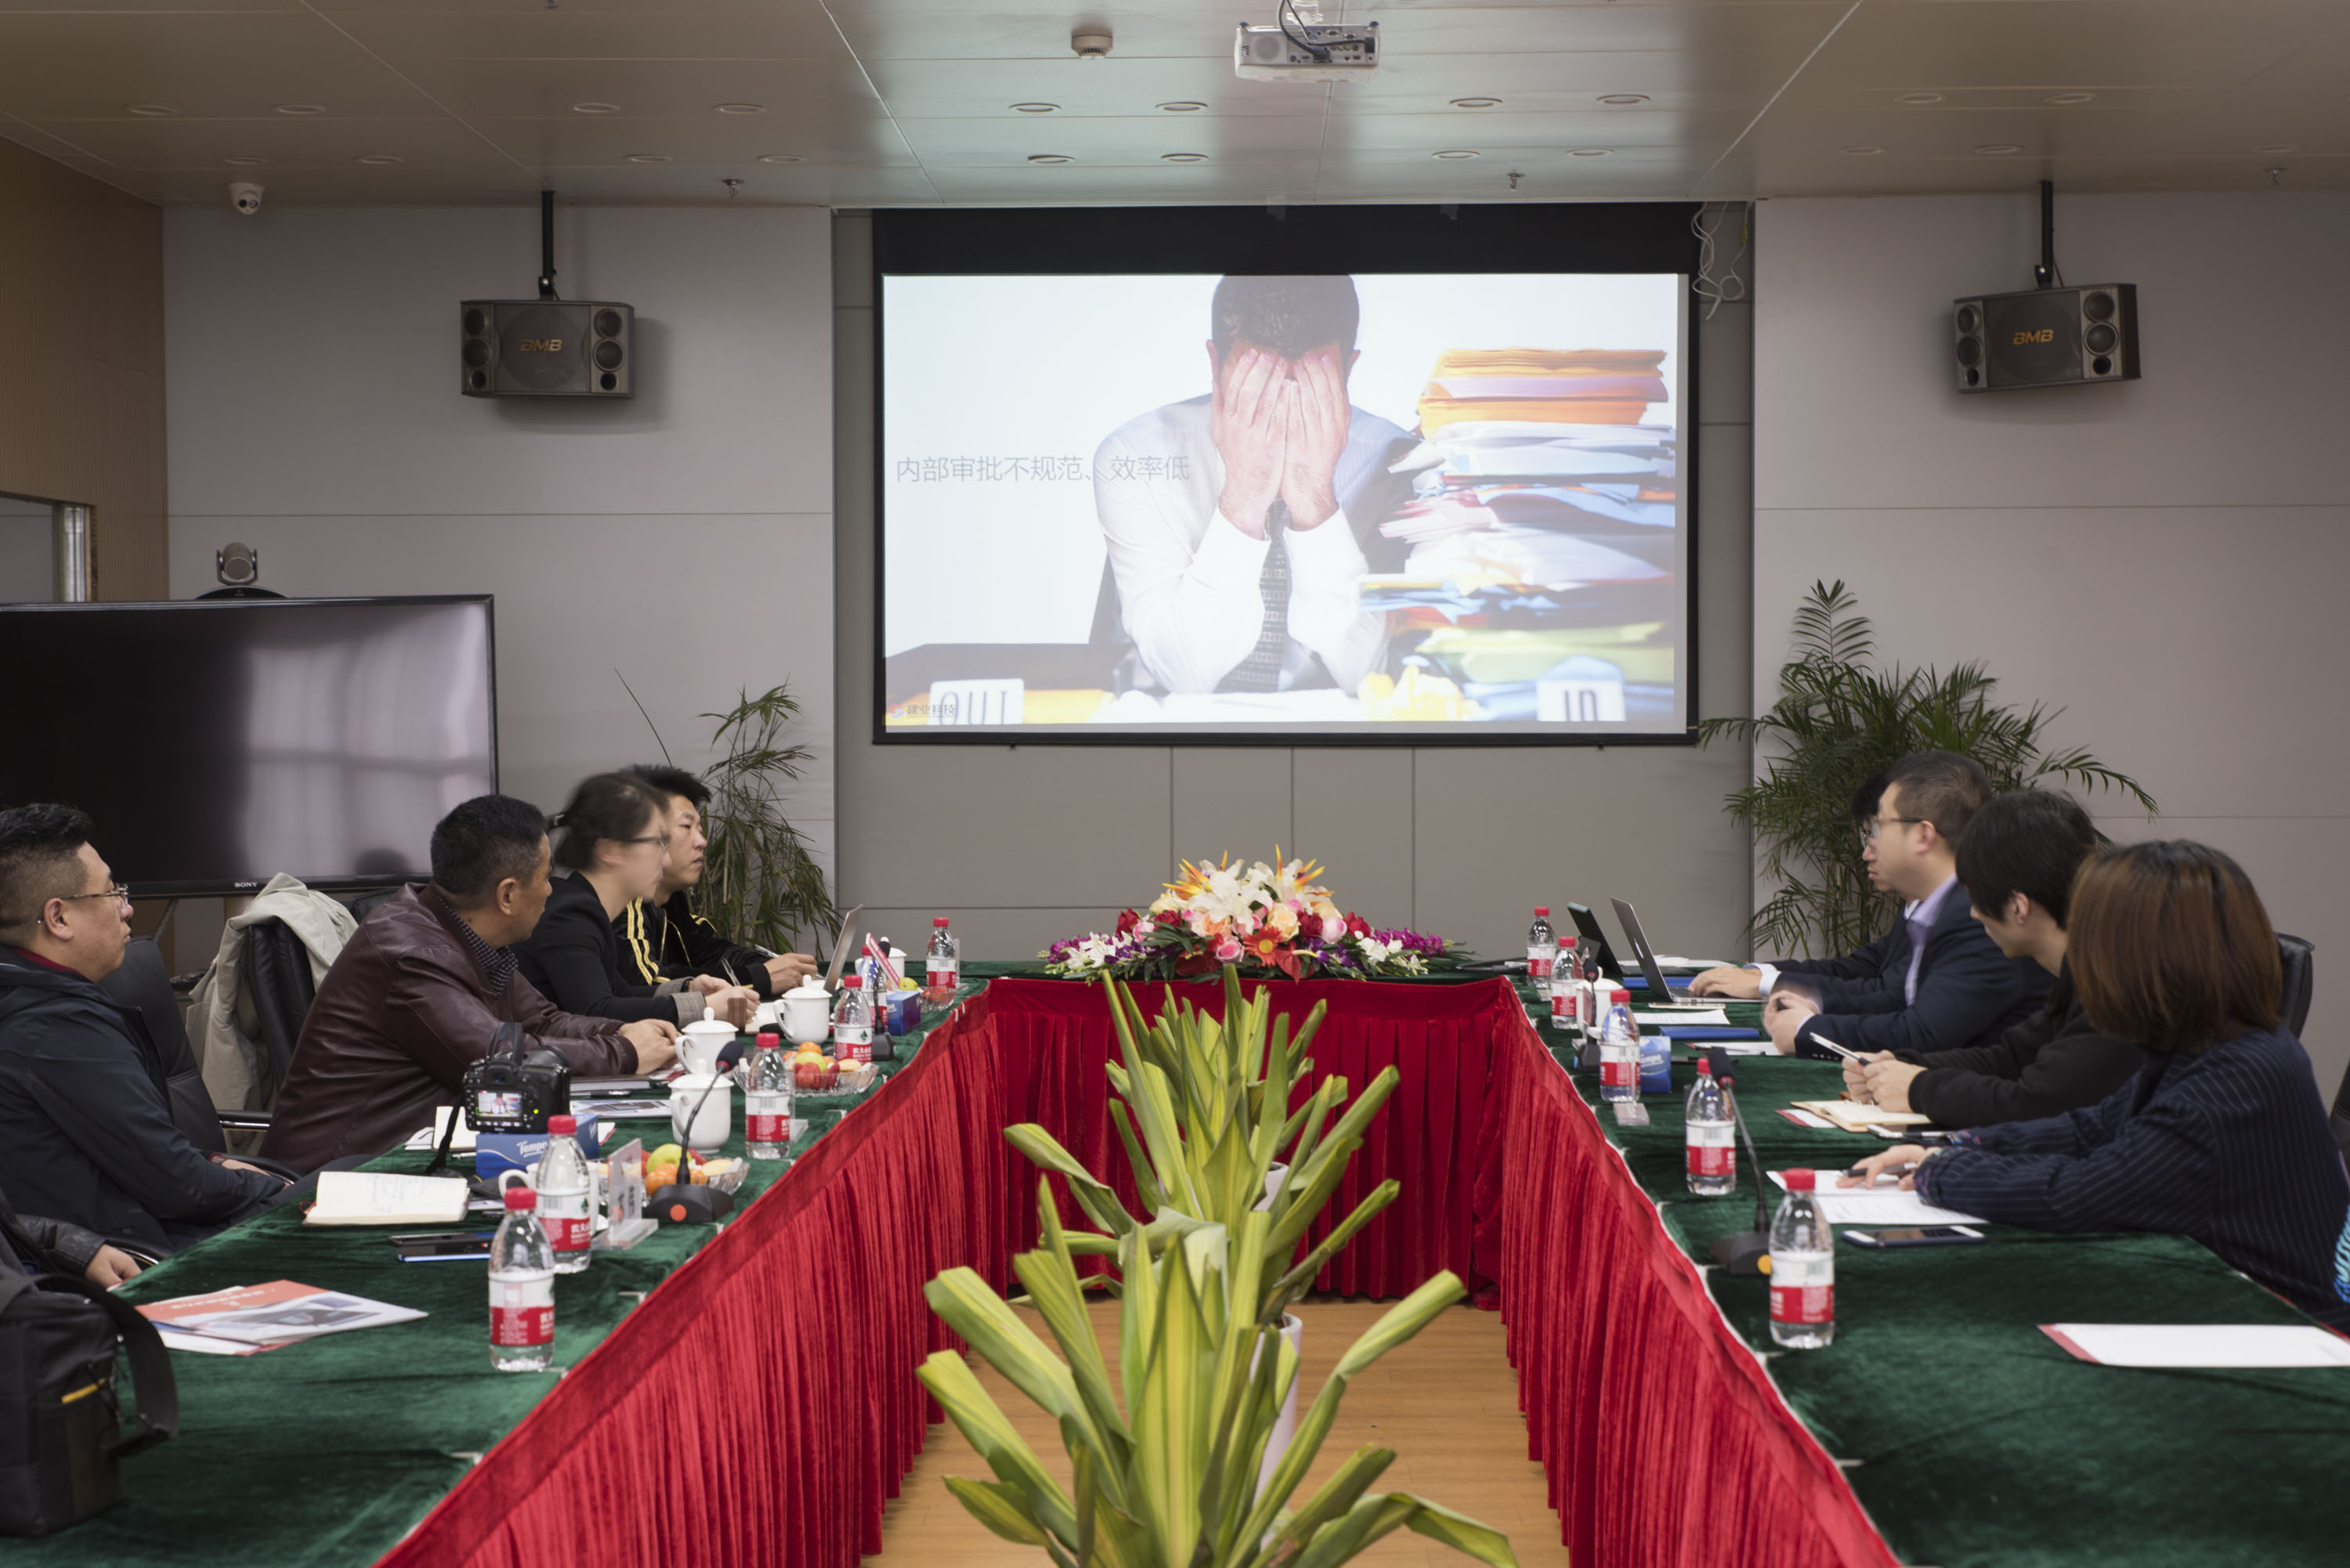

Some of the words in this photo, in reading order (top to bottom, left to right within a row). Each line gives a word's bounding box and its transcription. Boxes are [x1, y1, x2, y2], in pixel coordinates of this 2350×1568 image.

[2012, 329, 2054, 345] BMB
[520, 339, 562, 352] BMB
[896, 455, 1191, 482] 内部审批不规范、效率低
